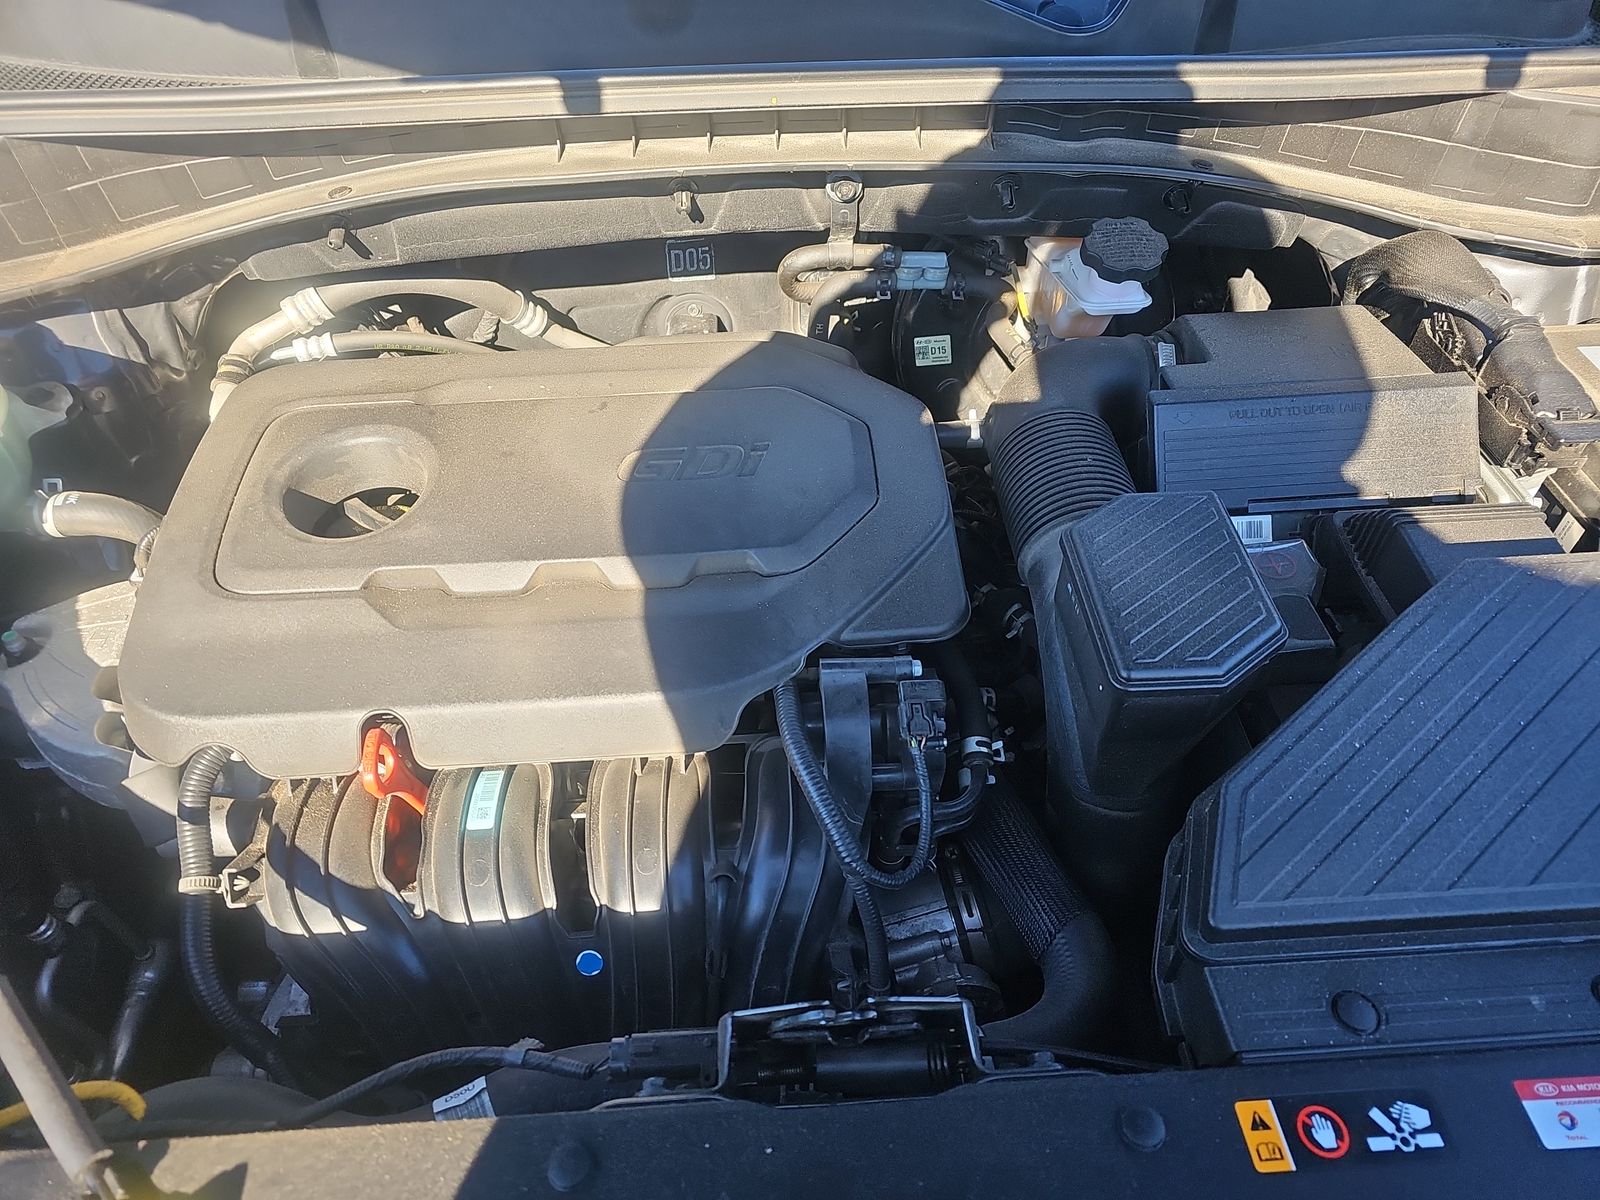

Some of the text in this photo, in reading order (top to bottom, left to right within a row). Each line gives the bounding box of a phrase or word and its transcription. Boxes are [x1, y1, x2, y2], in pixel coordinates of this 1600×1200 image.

[670, 246, 711, 272] D05
[930, 345, 947, 355] D15
[1229, 408, 1258, 420] PULL
[1261, 407, 1282, 418] OUT
[1283, 405, 1300, 416] TO
[1303, 403, 1335, 415] OPEN
[616, 441, 772, 482] GDi
[1536, 1083, 1556, 1095] KIA
[1561, 1084, 1577, 1092] KIA
